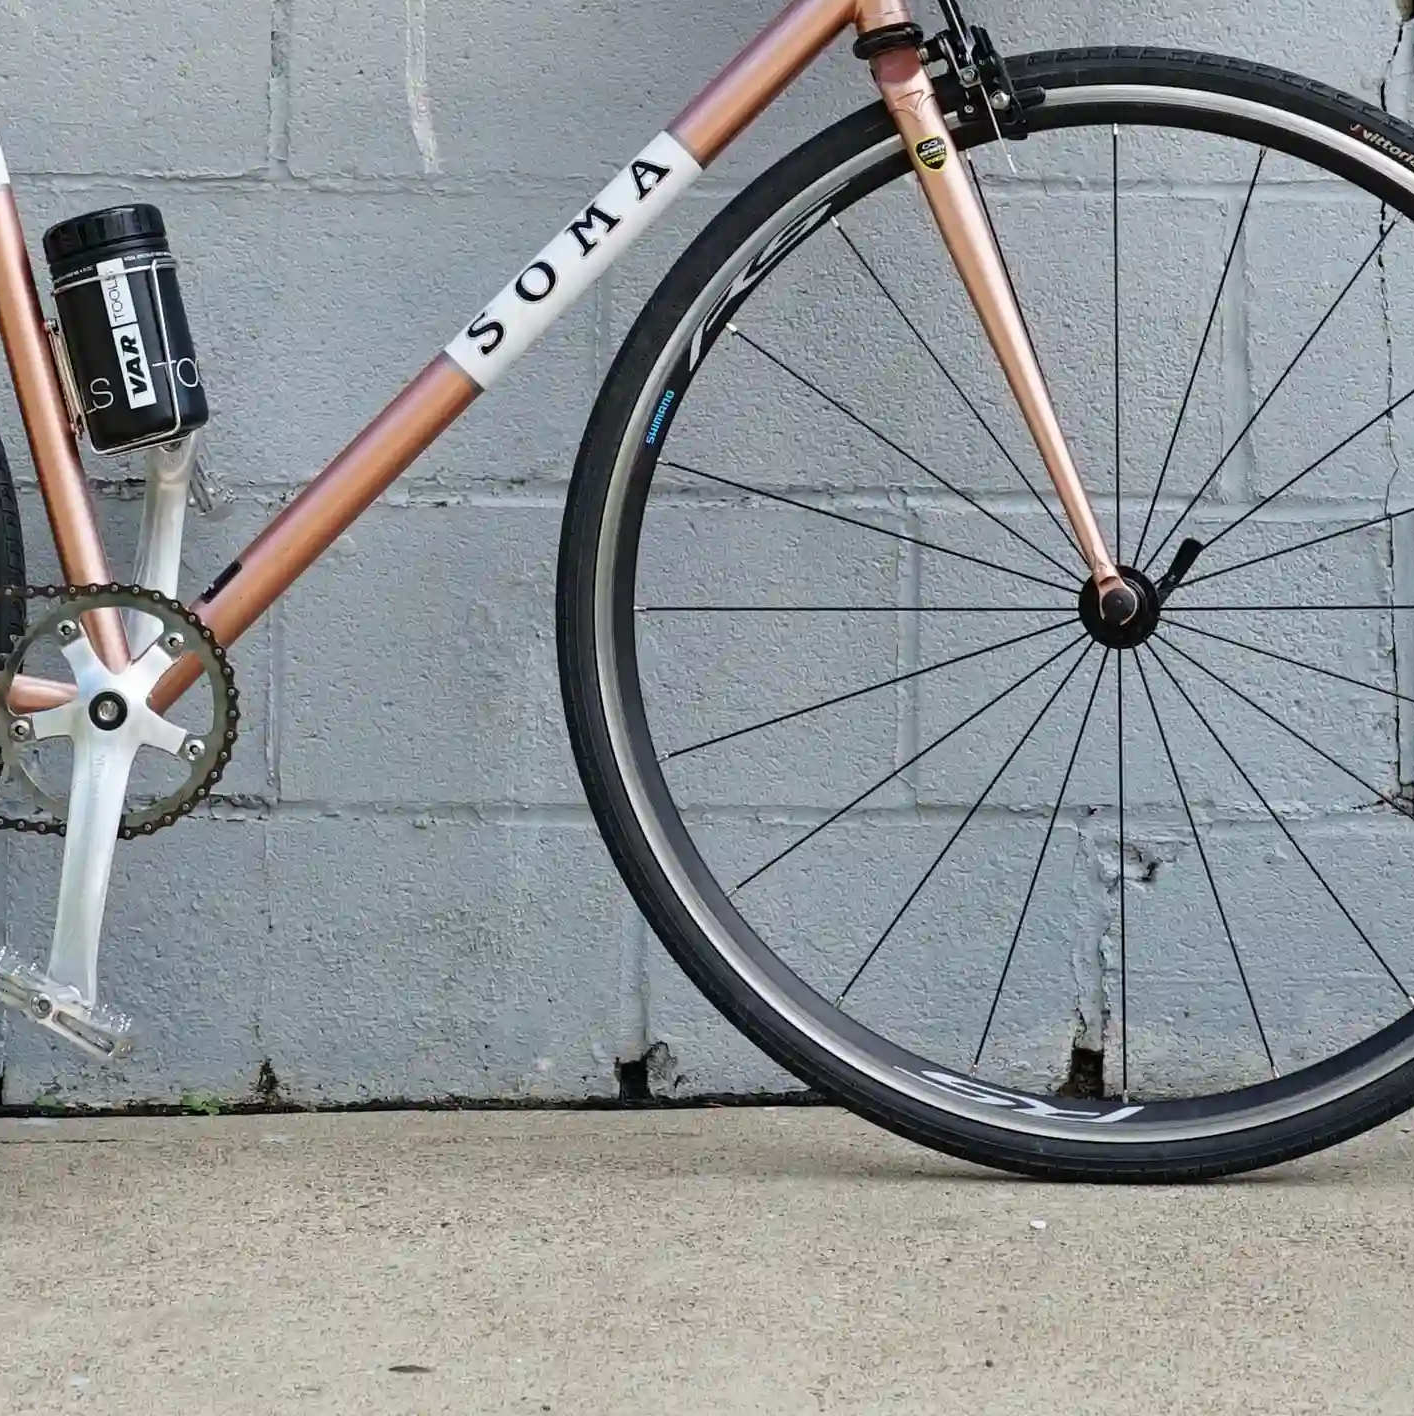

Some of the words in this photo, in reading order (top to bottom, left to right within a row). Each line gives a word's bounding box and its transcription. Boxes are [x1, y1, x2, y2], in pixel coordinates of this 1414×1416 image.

[467, 159, 671, 355] SOMA
[120, 335, 148, 400] VAR
[645, 389, 675, 445] SHIMANO
